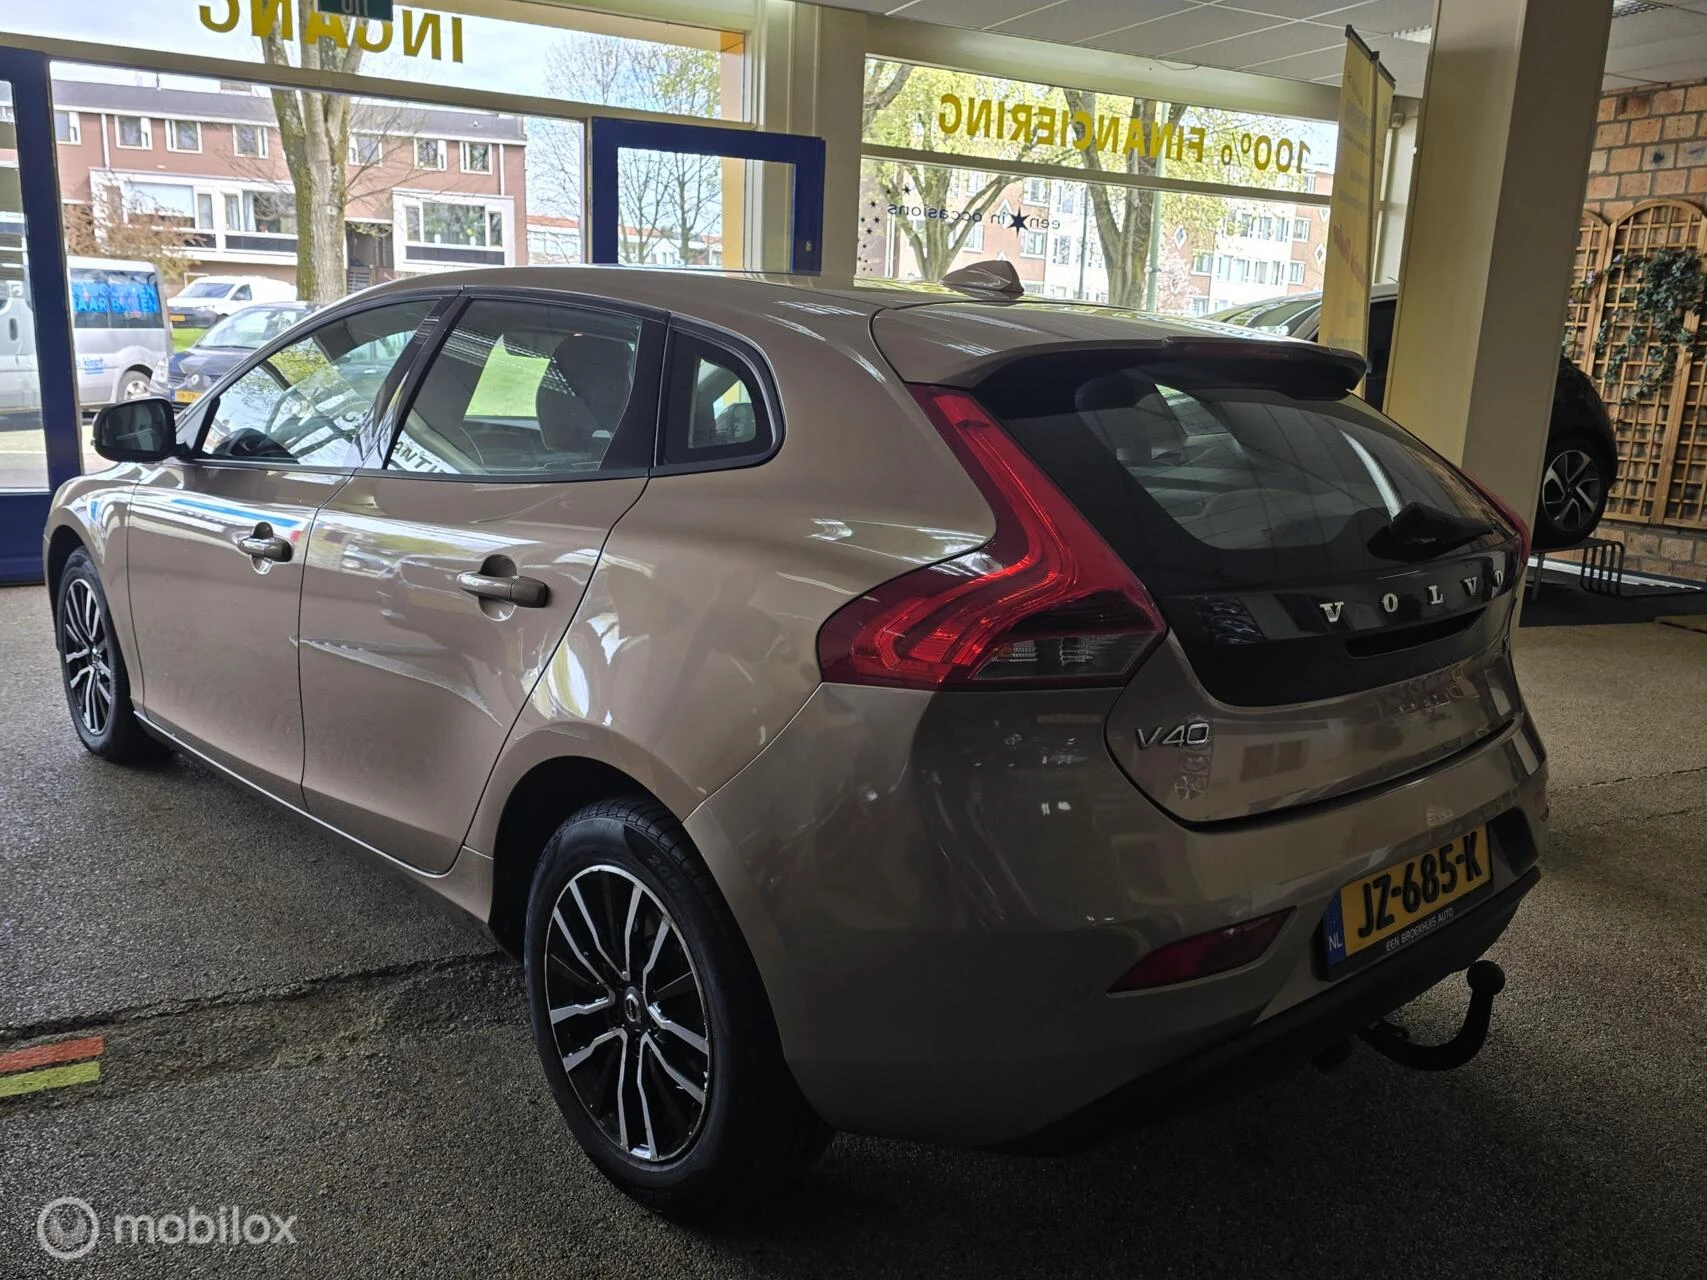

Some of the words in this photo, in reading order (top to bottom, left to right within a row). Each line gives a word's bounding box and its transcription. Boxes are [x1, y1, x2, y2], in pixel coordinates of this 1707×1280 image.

[1319, 570, 1504, 623] VOLVO
[1136, 723, 1209, 747] V40
[1357, 831, 1483, 939] JZ-685-K
[1328, 934, 1343, 952] NL
[1400, 917, 1437, 945] BROEKHUIS
[1438, 907, 1454, 926] AUTO
